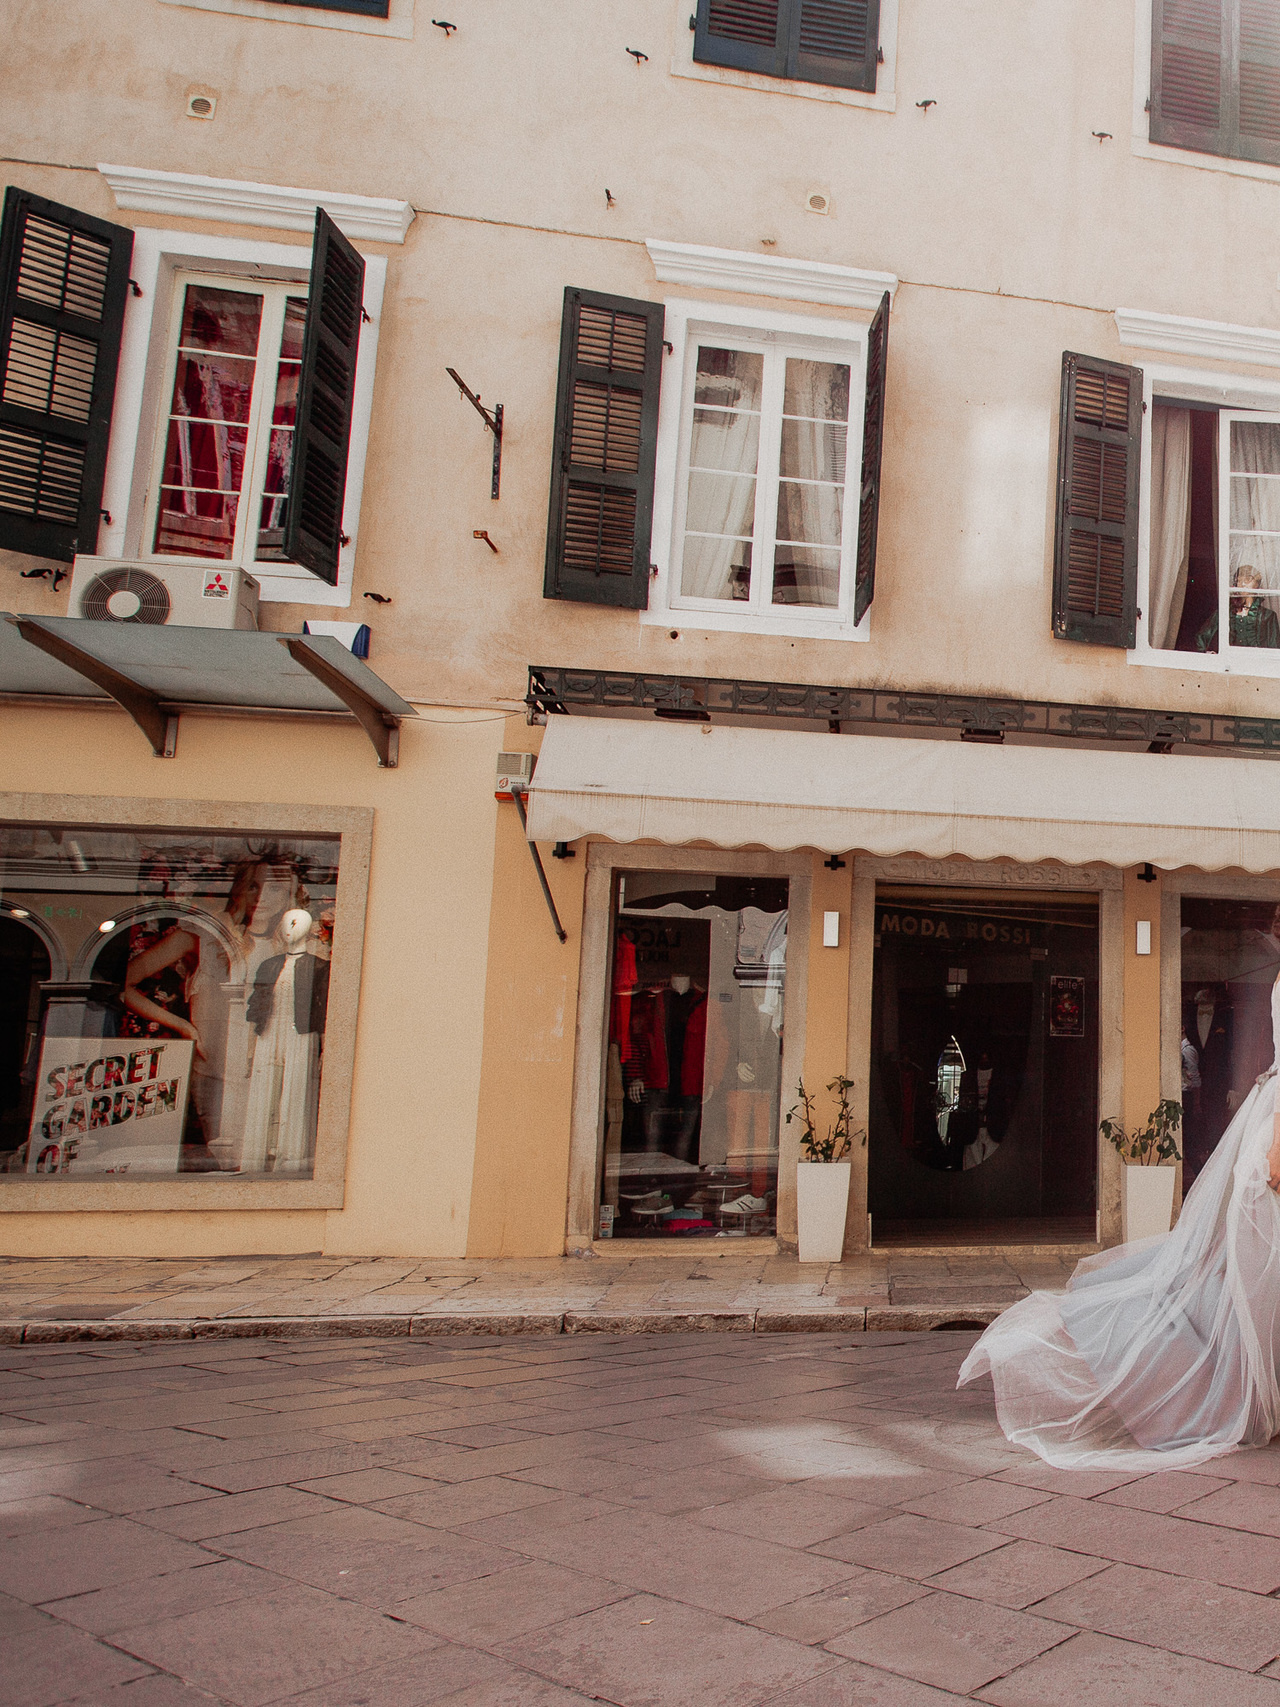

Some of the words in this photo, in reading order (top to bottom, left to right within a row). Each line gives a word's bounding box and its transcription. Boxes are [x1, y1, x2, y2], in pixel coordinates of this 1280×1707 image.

[881, 913, 950, 939] MODA
[966, 921, 1031, 945] ROSSI
[45, 1044, 168, 1102] SECRET
[41, 1077, 182, 1140] GARDEN
[35, 1136, 84, 1174] OF
